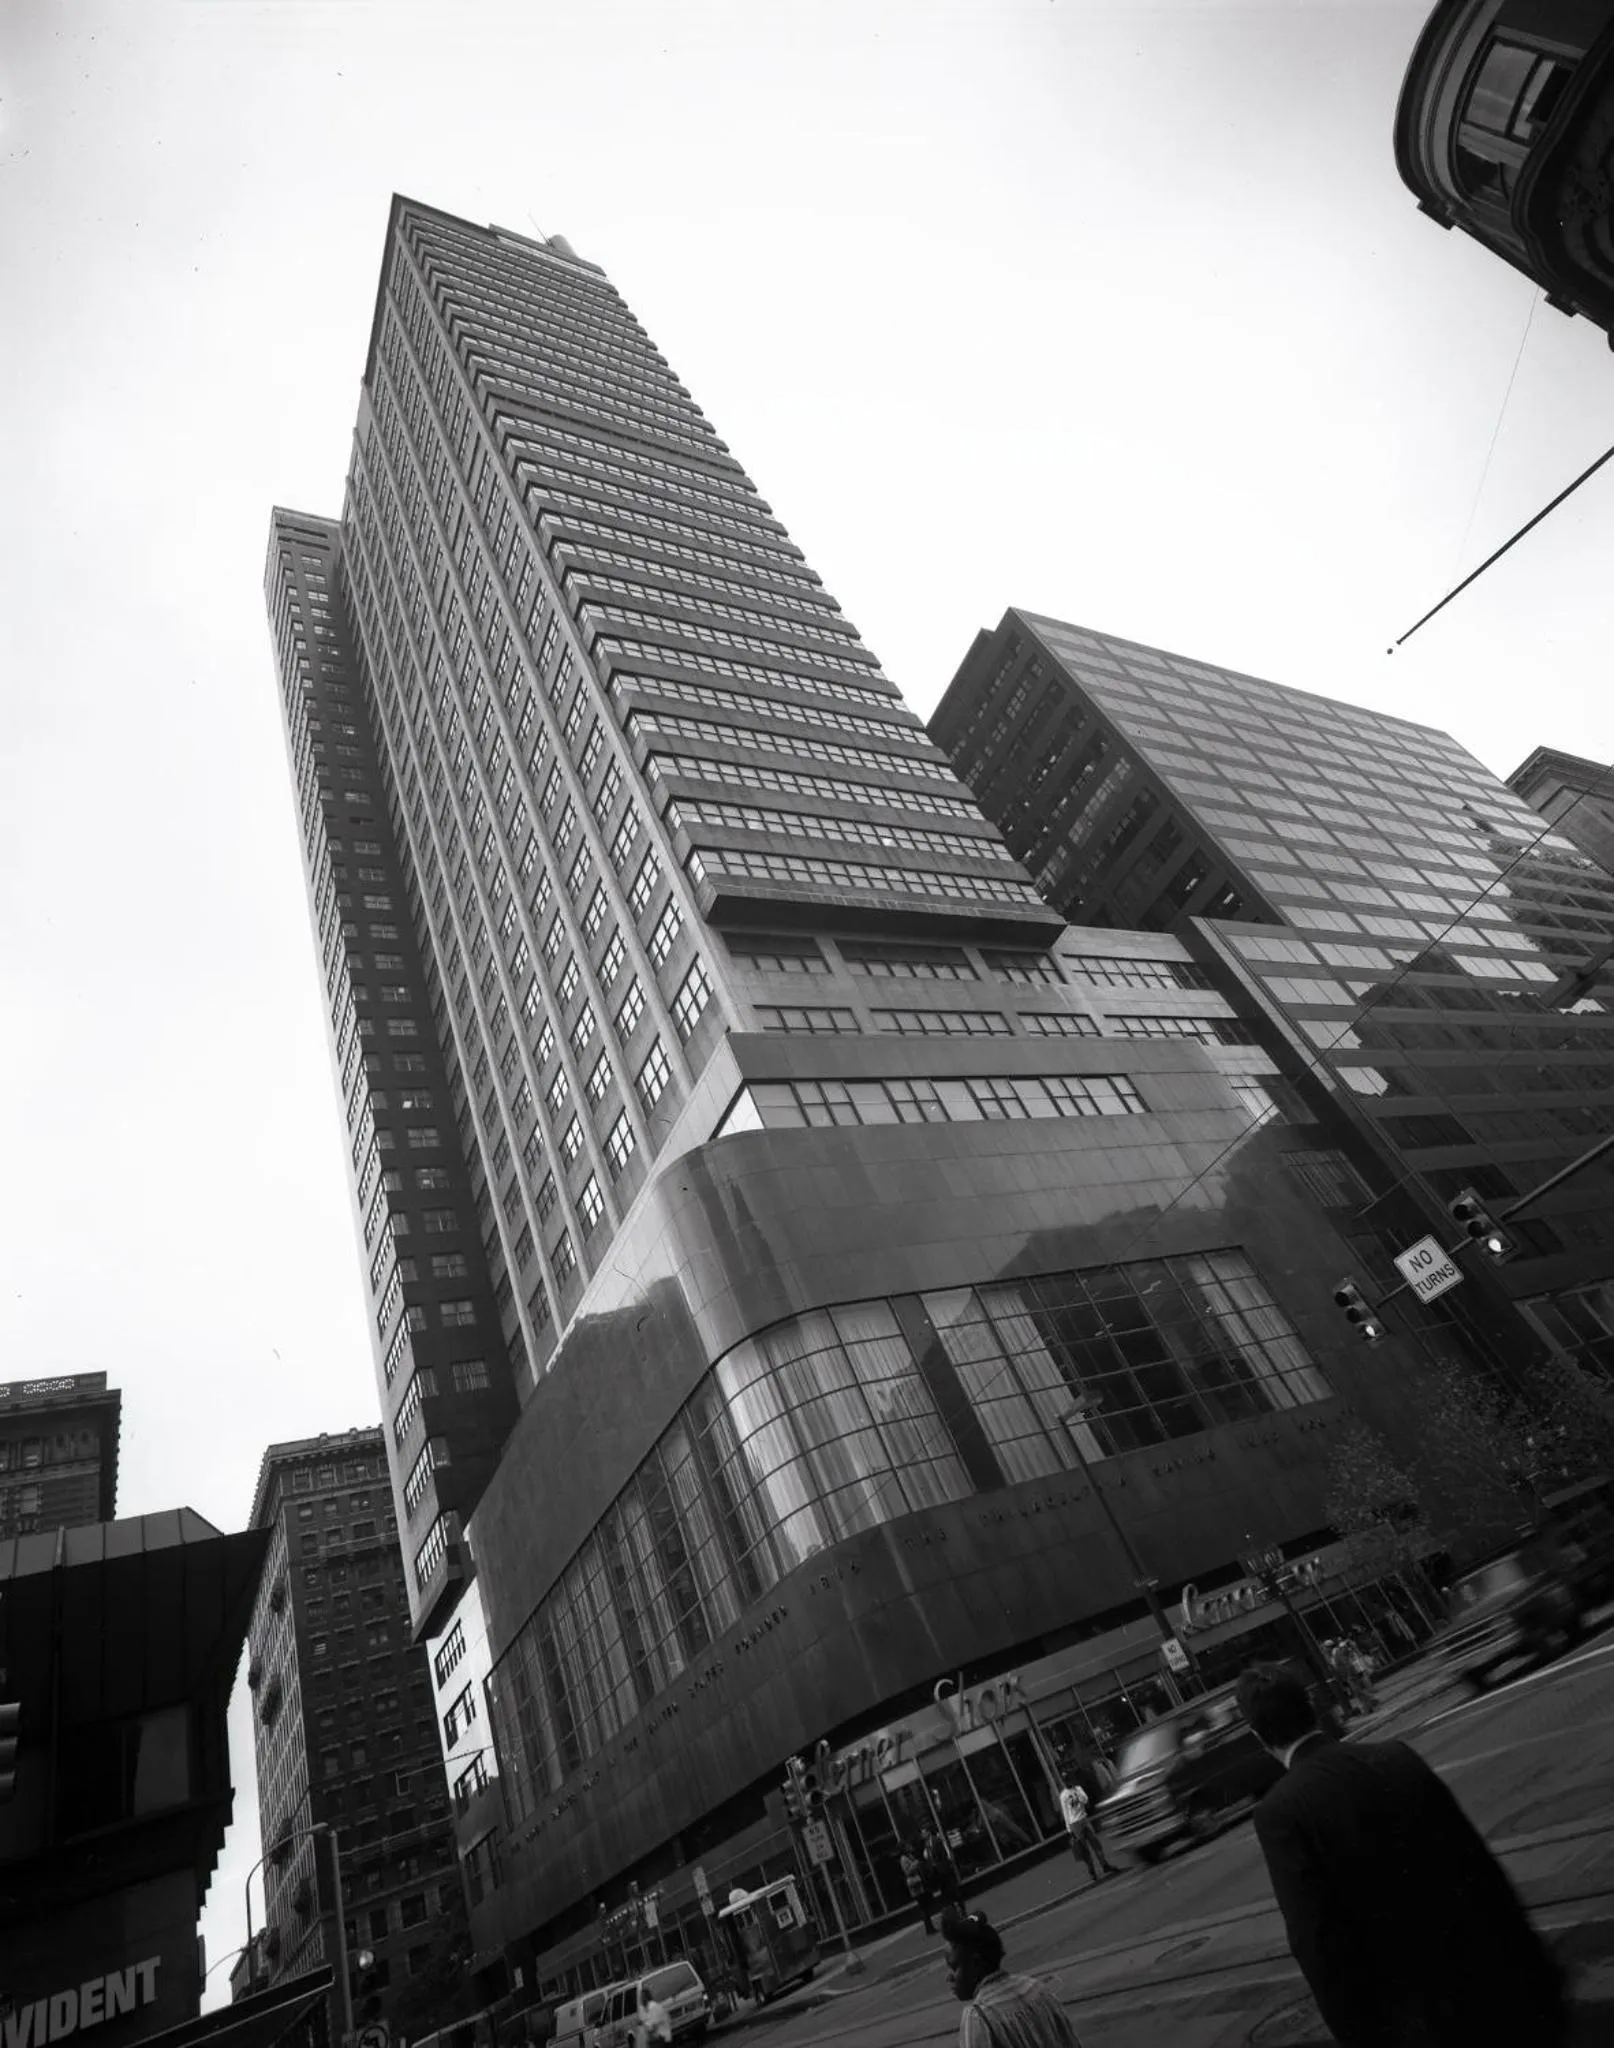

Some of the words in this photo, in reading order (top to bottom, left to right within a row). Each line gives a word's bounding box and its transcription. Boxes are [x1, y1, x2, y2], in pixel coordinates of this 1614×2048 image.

[1408, 1249, 1434, 1273] NO
[1415, 1263, 1455, 1294] TURNS
[0, 1955, 162, 2048] VIDENT
